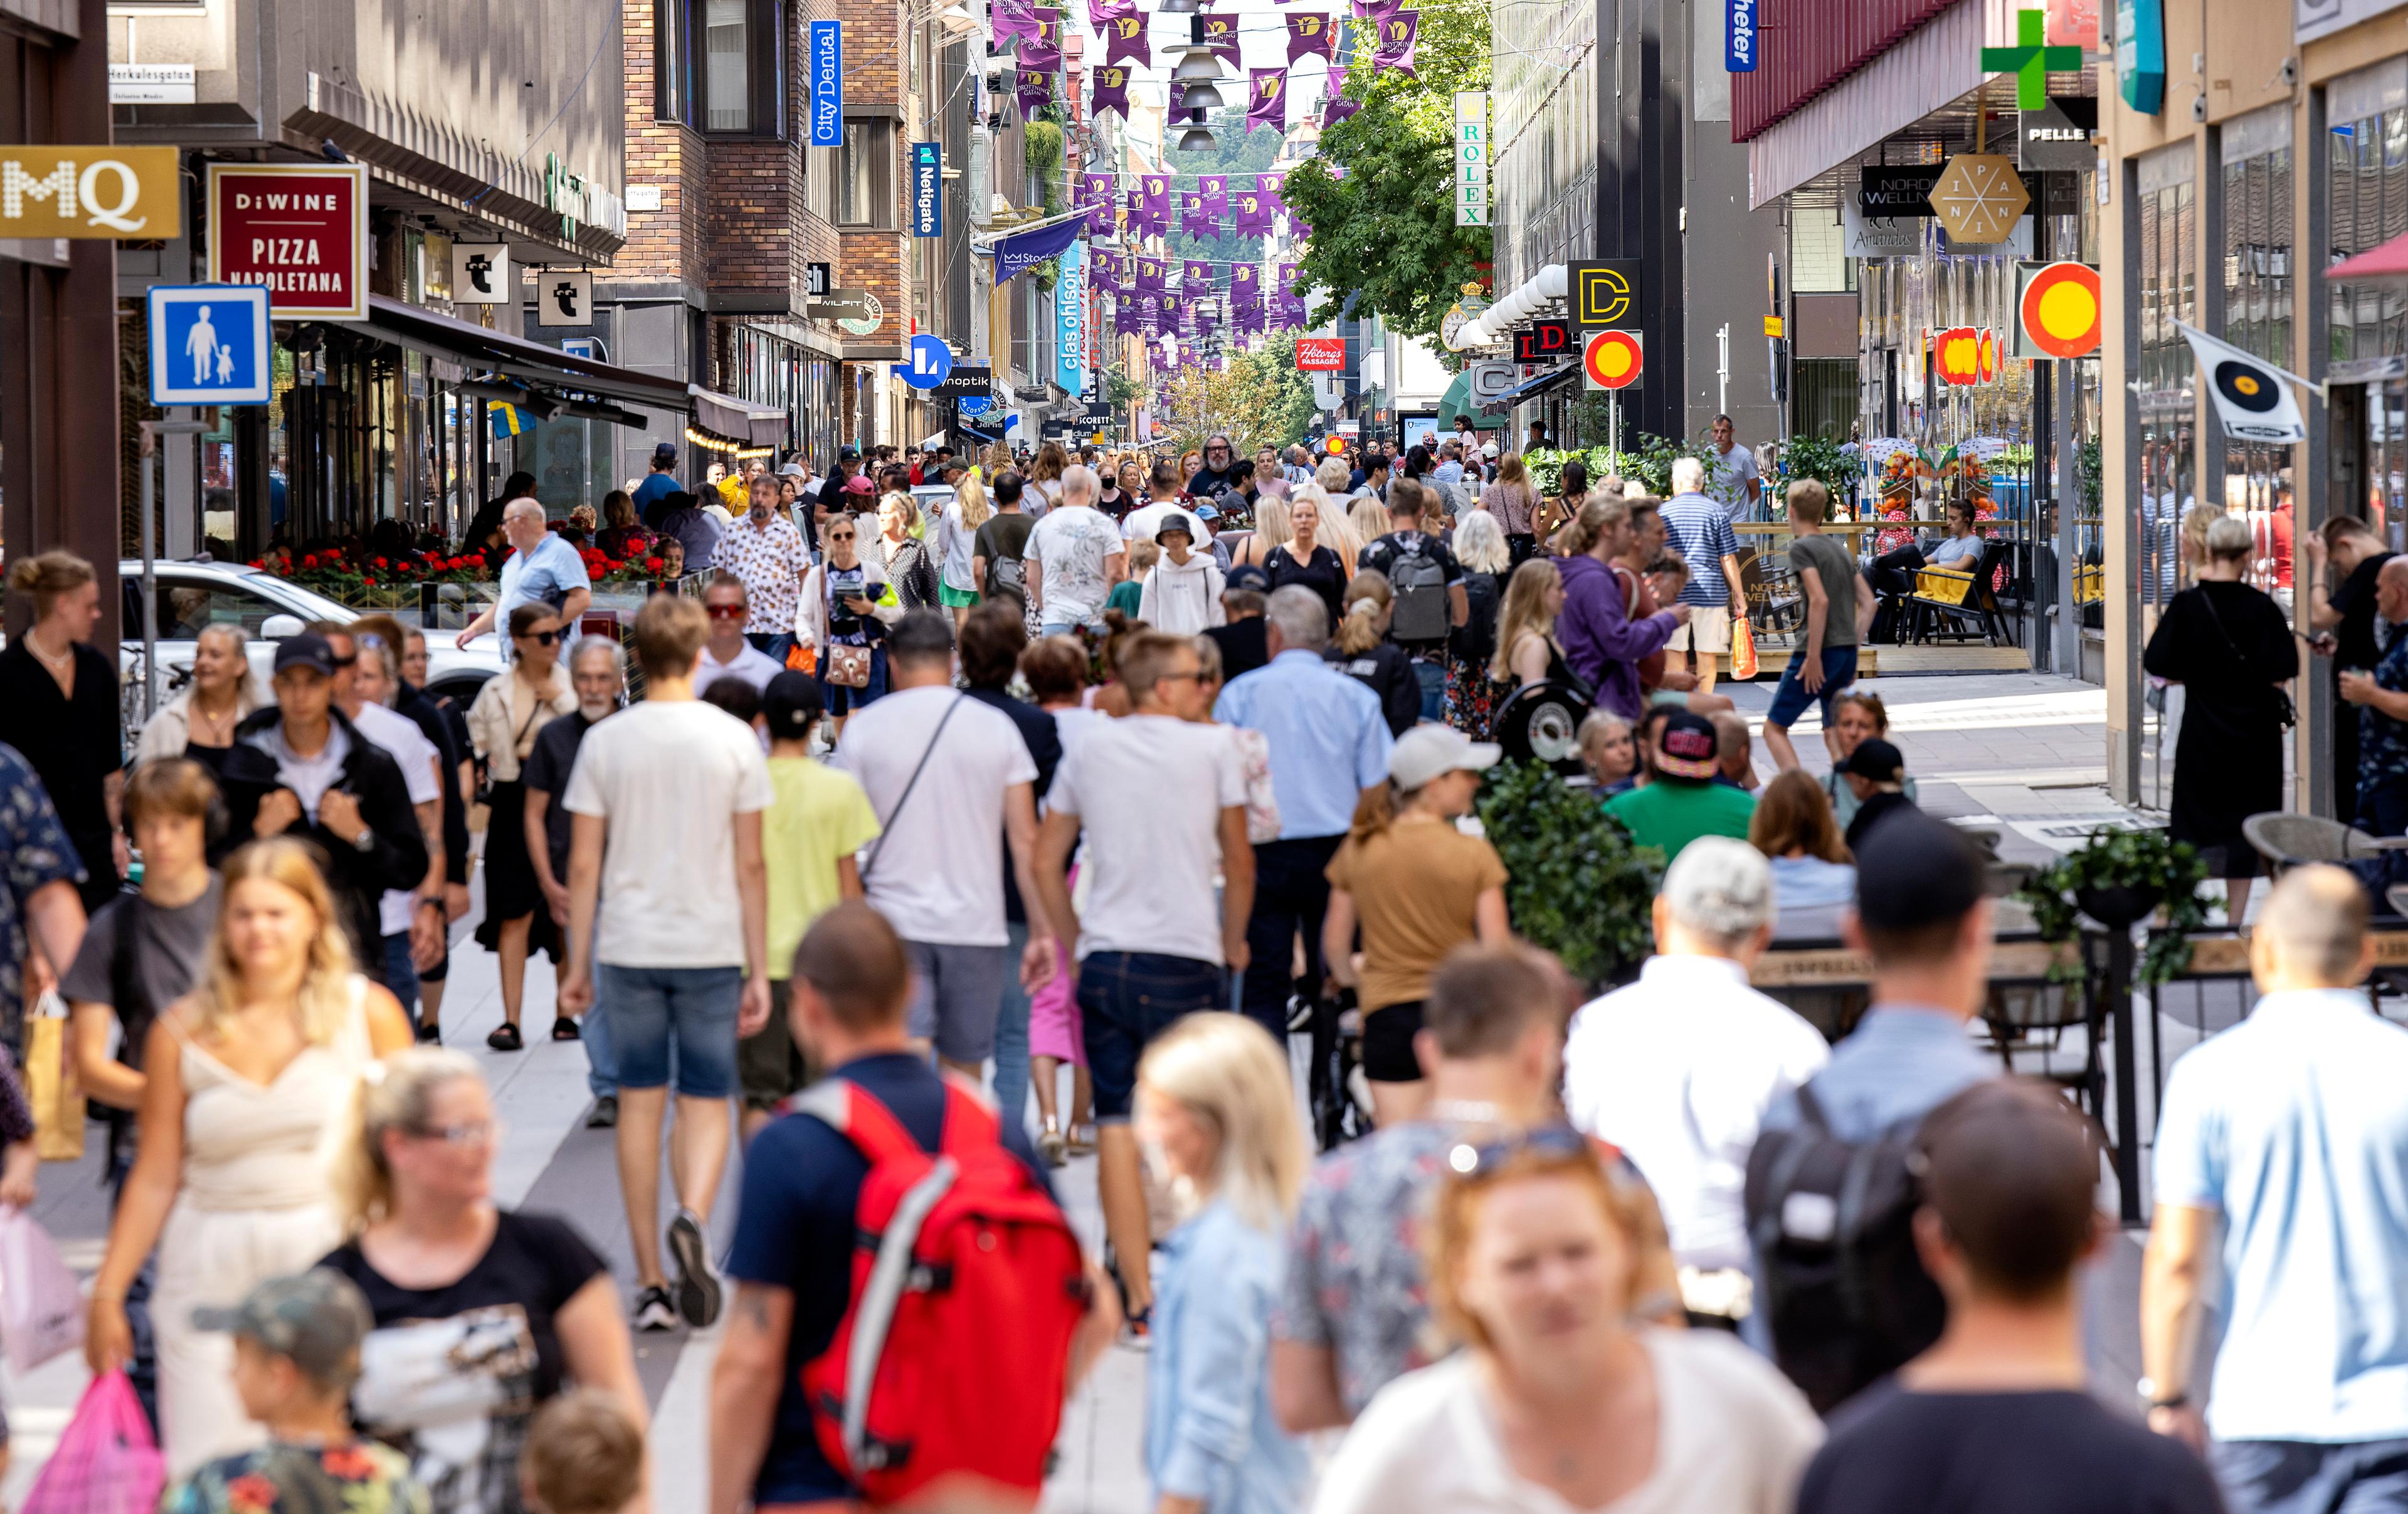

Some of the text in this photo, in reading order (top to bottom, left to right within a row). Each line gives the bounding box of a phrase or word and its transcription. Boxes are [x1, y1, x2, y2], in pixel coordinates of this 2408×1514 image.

[817, 26, 838, 140] City Dental
[2029, 129, 2085, 141] PELLE
[1464, 125, 1480, 223] ROLEX
[3, 160, 147, 232] MQ
[236, 193, 337, 211] DiWINE
[918, 167, 934, 233] Netigate
[252, 238, 320, 265] PIZZA
[230, 271, 342, 292] NAPOLETANA
[1060, 266, 1077, 370] clas ohlson
[966, 402, 988, 414] COFFEE
[1079, 416, 1109, 424] SCORETT
